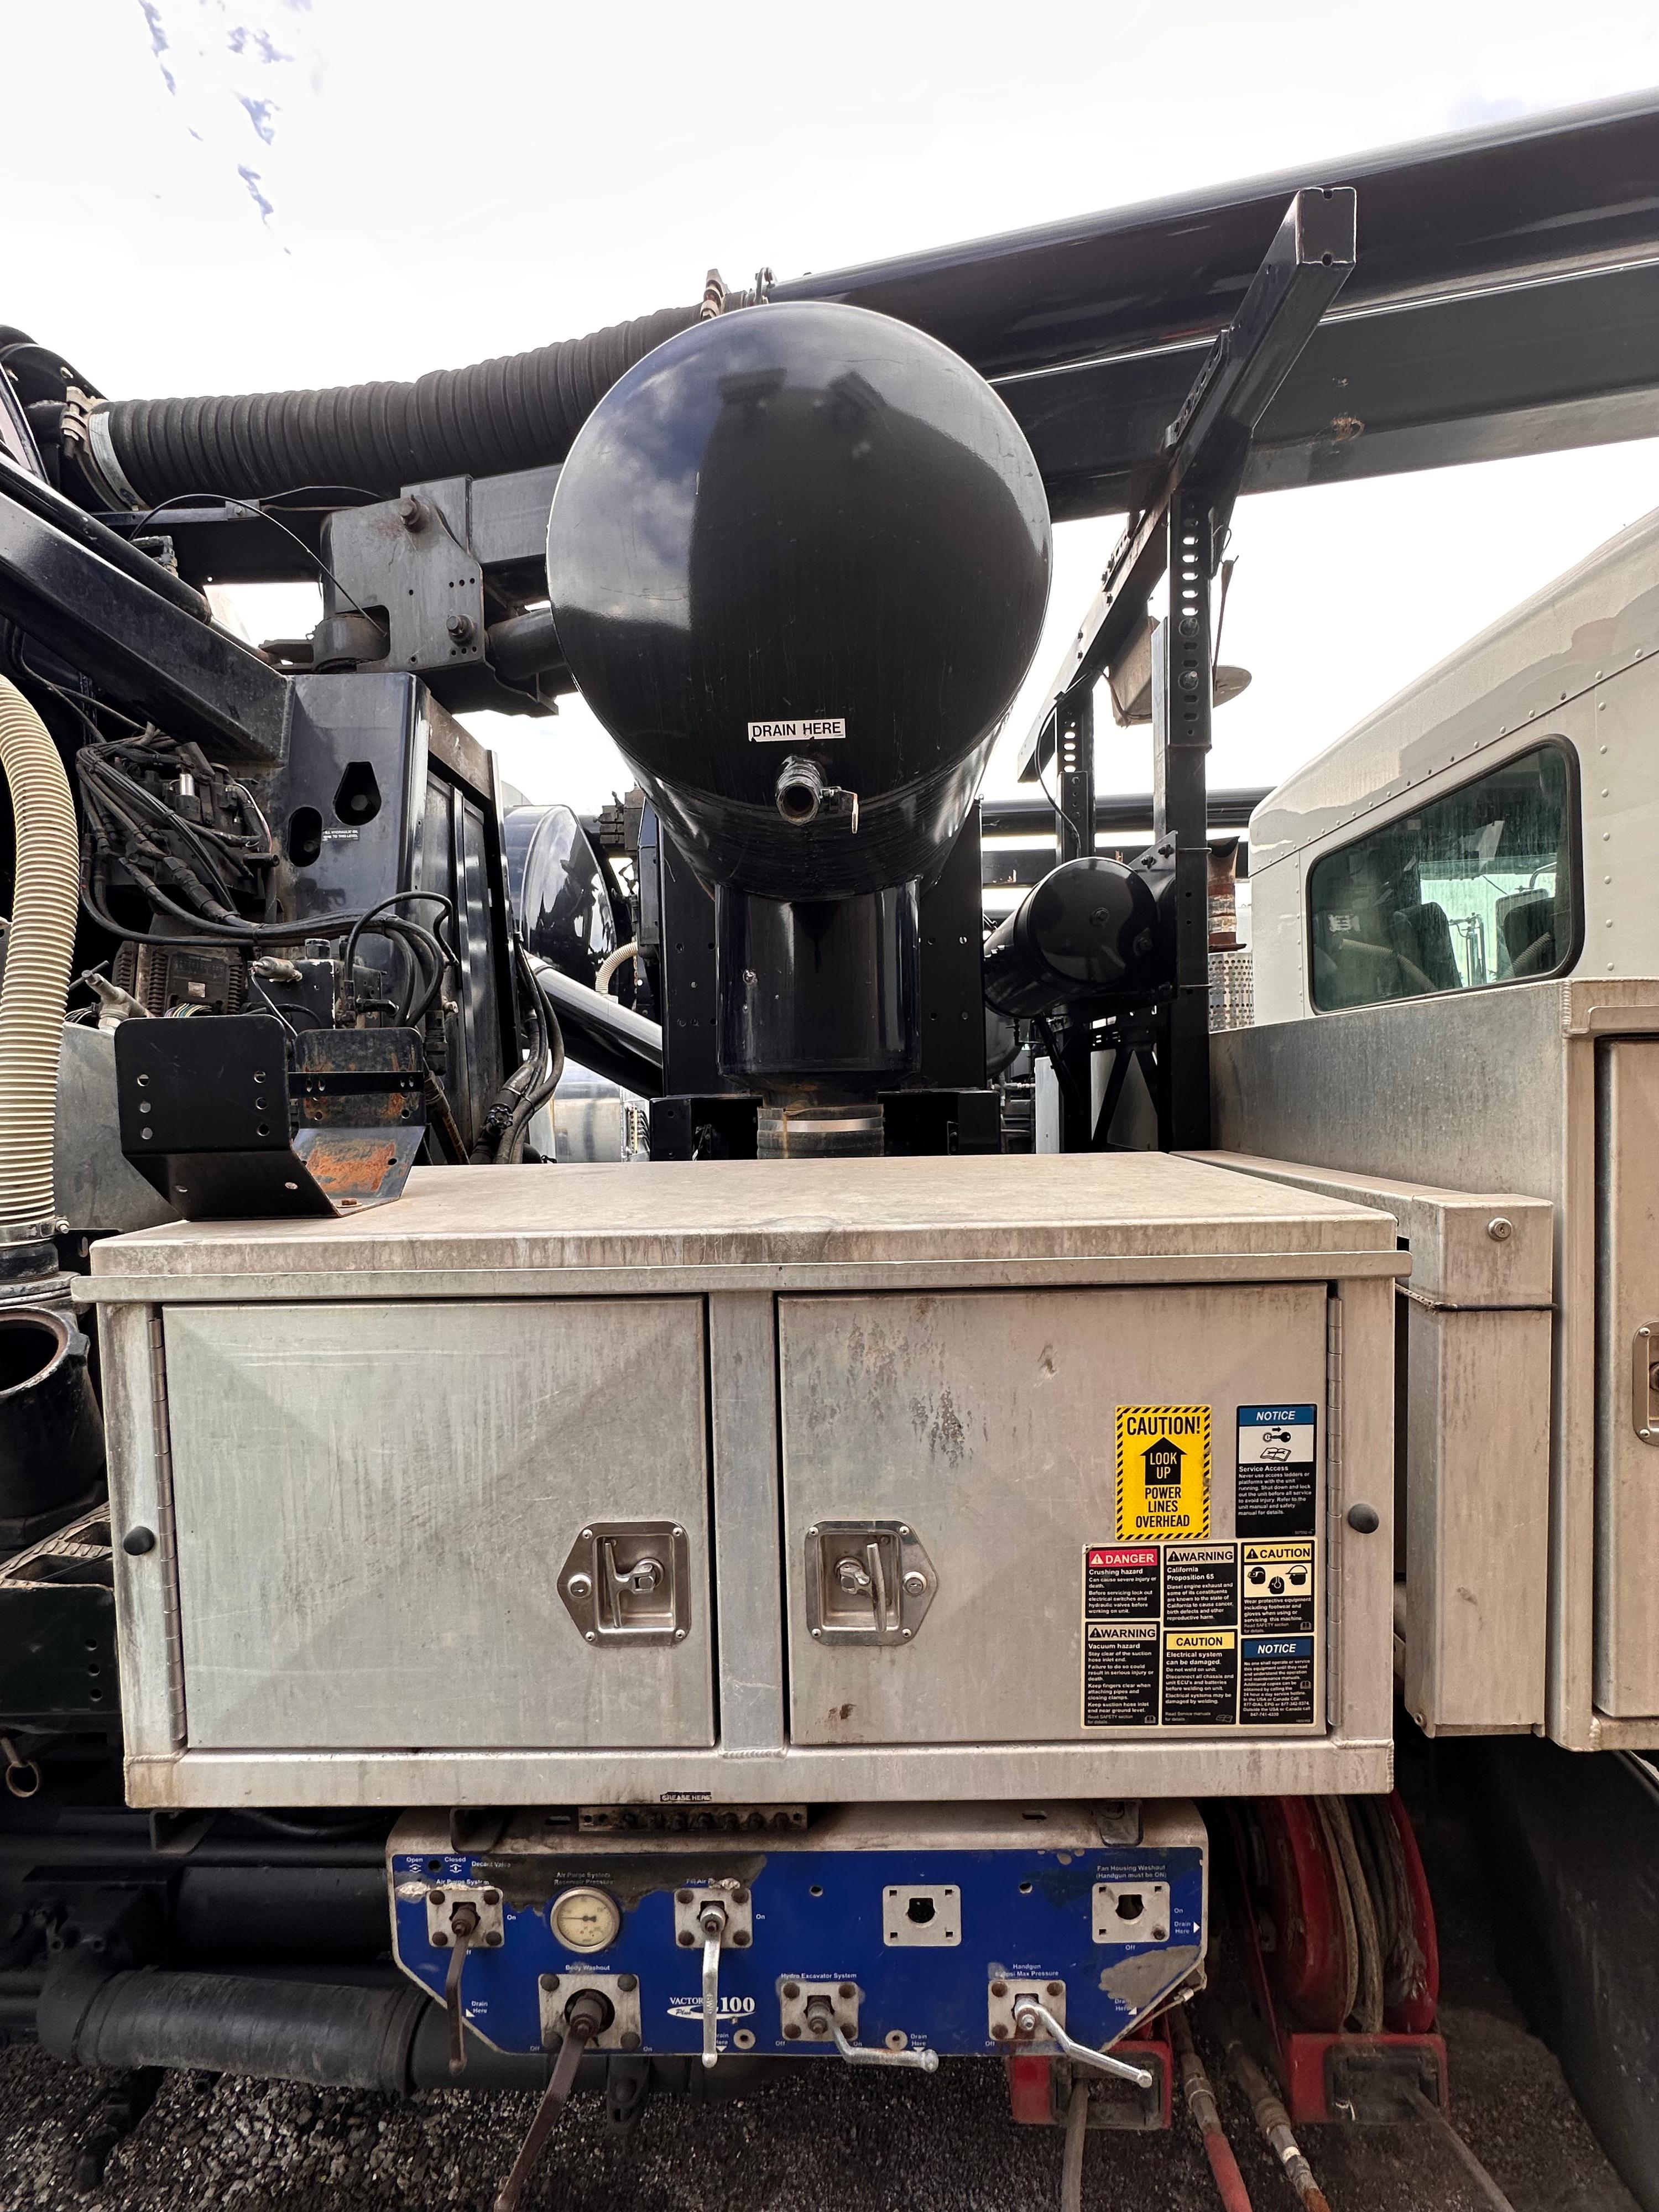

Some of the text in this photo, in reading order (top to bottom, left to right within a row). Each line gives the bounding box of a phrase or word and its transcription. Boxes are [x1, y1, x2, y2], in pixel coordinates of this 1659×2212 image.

[753, 722, 841, 737] DRAIN HERE
[1256, 1411, 1296, 1421] NOTICE
[1127, 1416, 1200, 1435] CAUTION!
[1150, 1452, 1177, 1465] LOOK
[1156, 1467, 1171, 1479] UP
[1145, 1487, 1181, 1499] POWER
[1149, 1500, 1178, 1512] LINES
[1136, 1515, 1190, 1528] OVERHEAD
[1106, 1553, 1155, 1564] DANGER
[1180, 1551, 1233, 1561] WARNING
[1260, 1548, 1310, 1558] CAUTION
[1101, 1629, 1155, 1637] WARNING
[1176, 1637, 1223, 1646] CAUTION
[1258, 1644, 1297, 1653] NOTICE
[717, 1997, 755, 2012] 100
